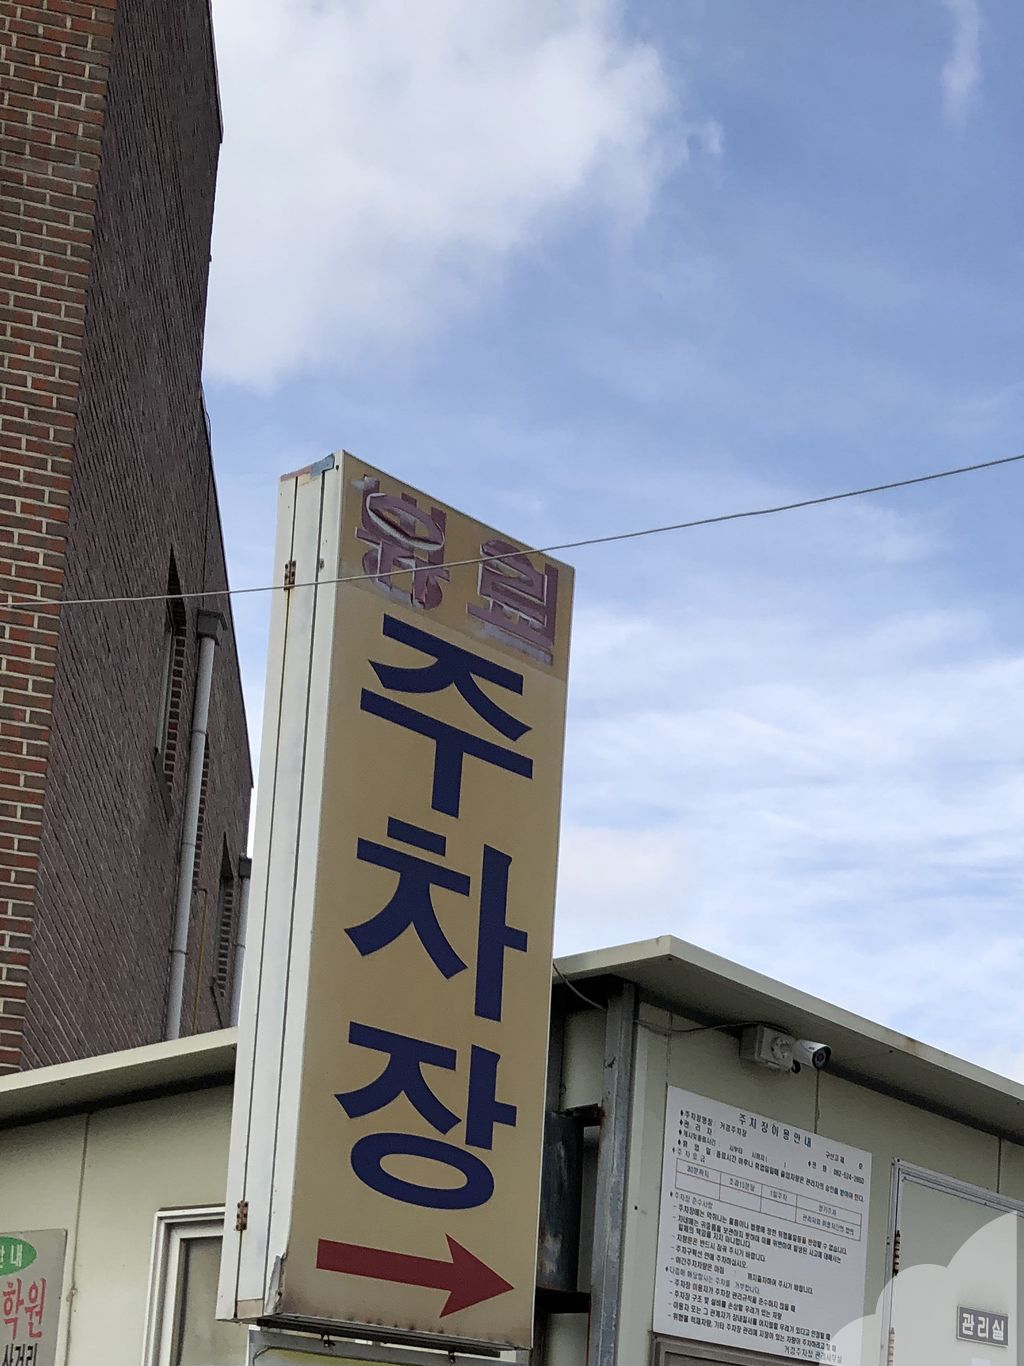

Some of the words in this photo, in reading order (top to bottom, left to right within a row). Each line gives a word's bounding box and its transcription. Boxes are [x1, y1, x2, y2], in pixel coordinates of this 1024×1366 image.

[334, 615, 532, 1209] 주차장
[0, 1244, 23, 1268] 내
[3, 1277, 47, 1340] 학원
[962, 1313, 1004, 1341] 관리실
